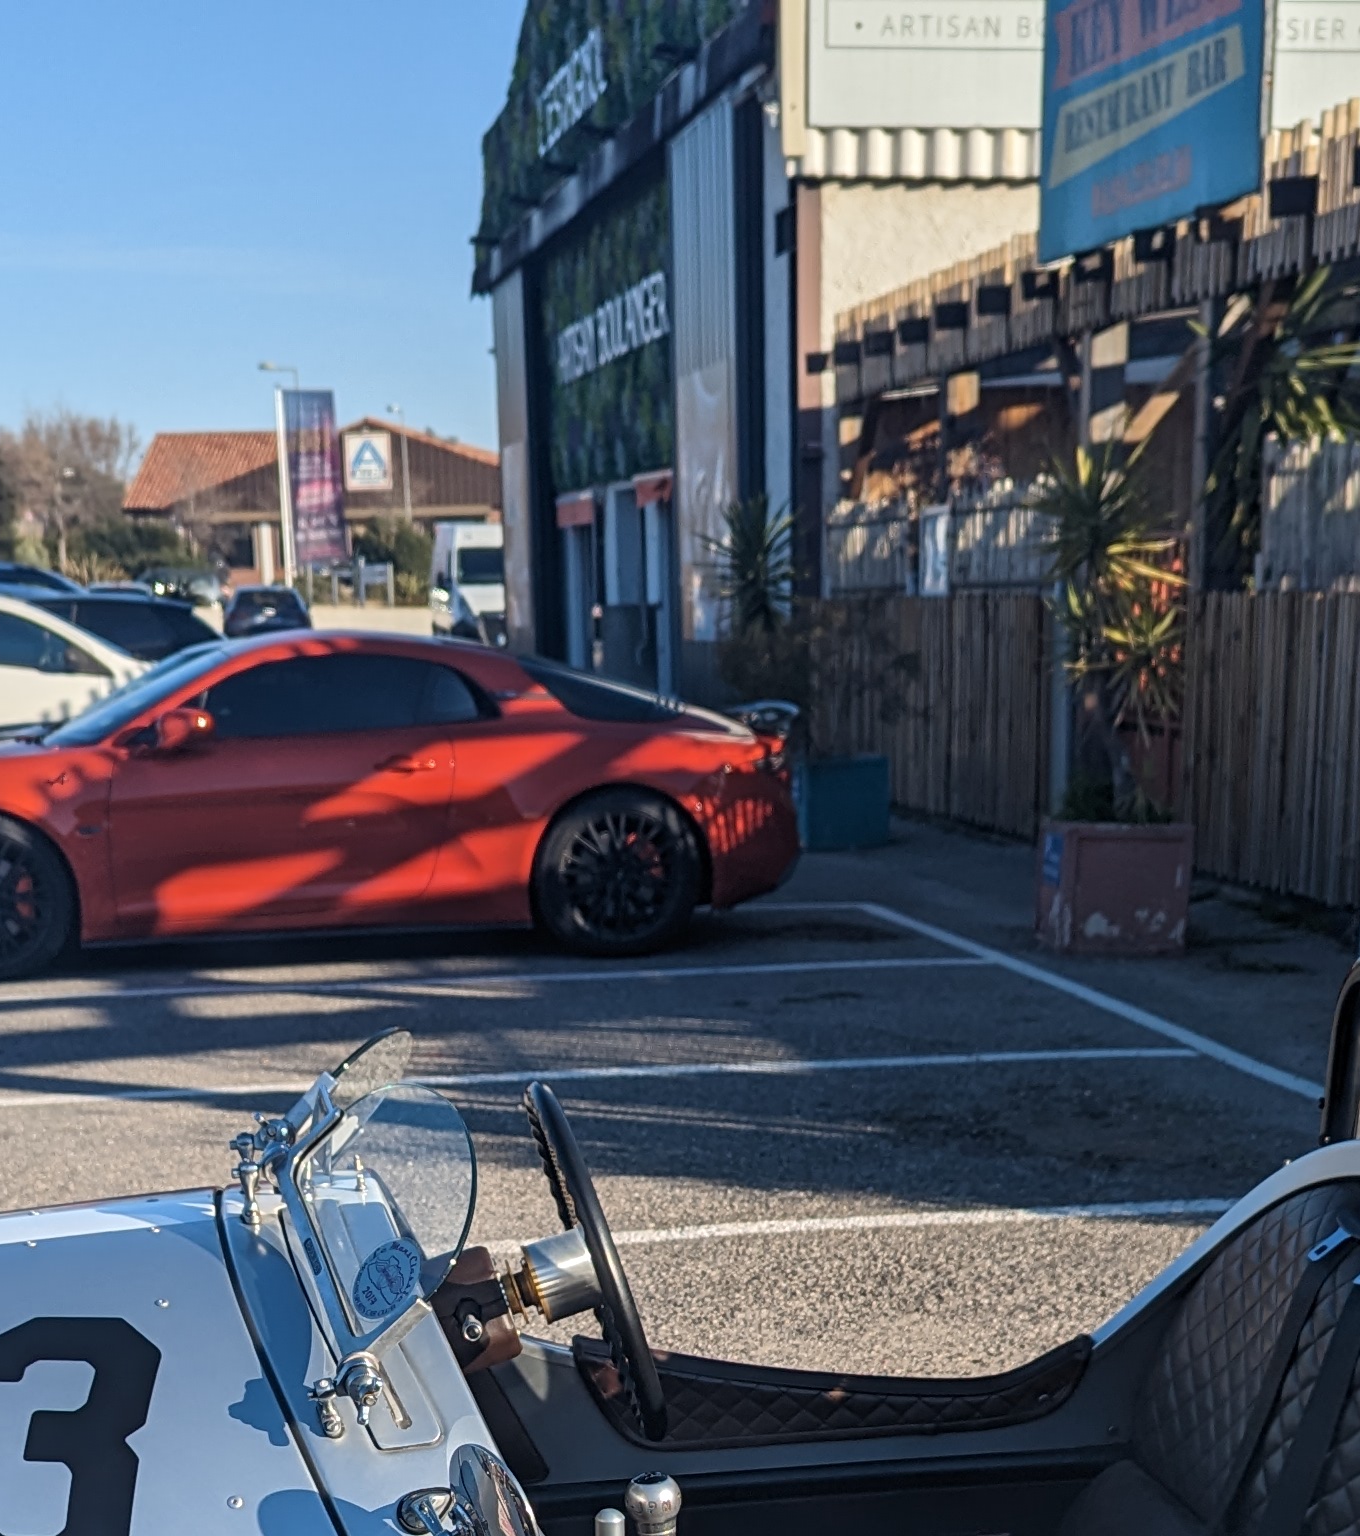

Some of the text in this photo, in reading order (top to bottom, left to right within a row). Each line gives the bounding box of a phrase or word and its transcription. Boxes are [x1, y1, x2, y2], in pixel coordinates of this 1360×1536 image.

[880, 15, 1002, 39] ARTISAN
[1064, 36, 1228, 154] RESTAURANT BAR
